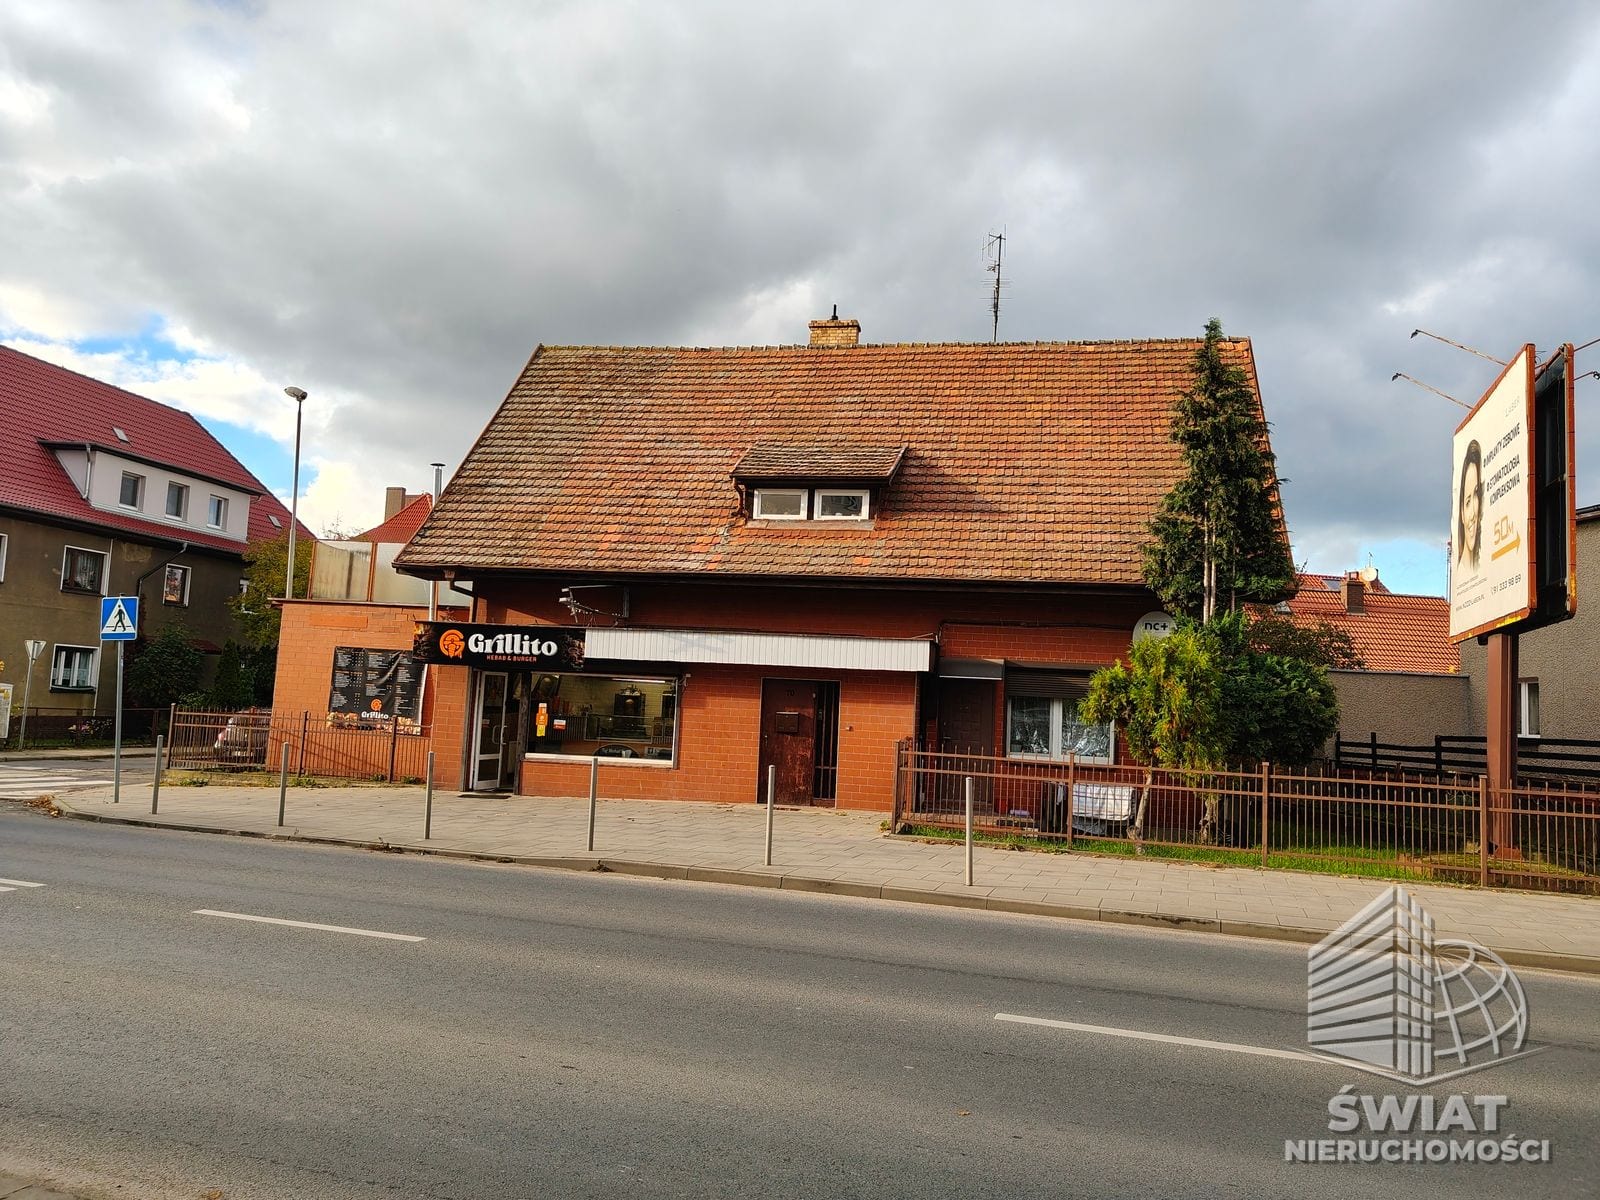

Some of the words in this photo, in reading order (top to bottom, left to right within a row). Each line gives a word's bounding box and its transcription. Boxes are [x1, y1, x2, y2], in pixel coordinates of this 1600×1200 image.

[1489, 454, 1520, 490] STOMATOLOGIA
[1490, 473, 1520, 506] KOMPLEKSOWA
[1144, 622, 1169, 631] nc+
[468, 633, 558, 656] Grillito
